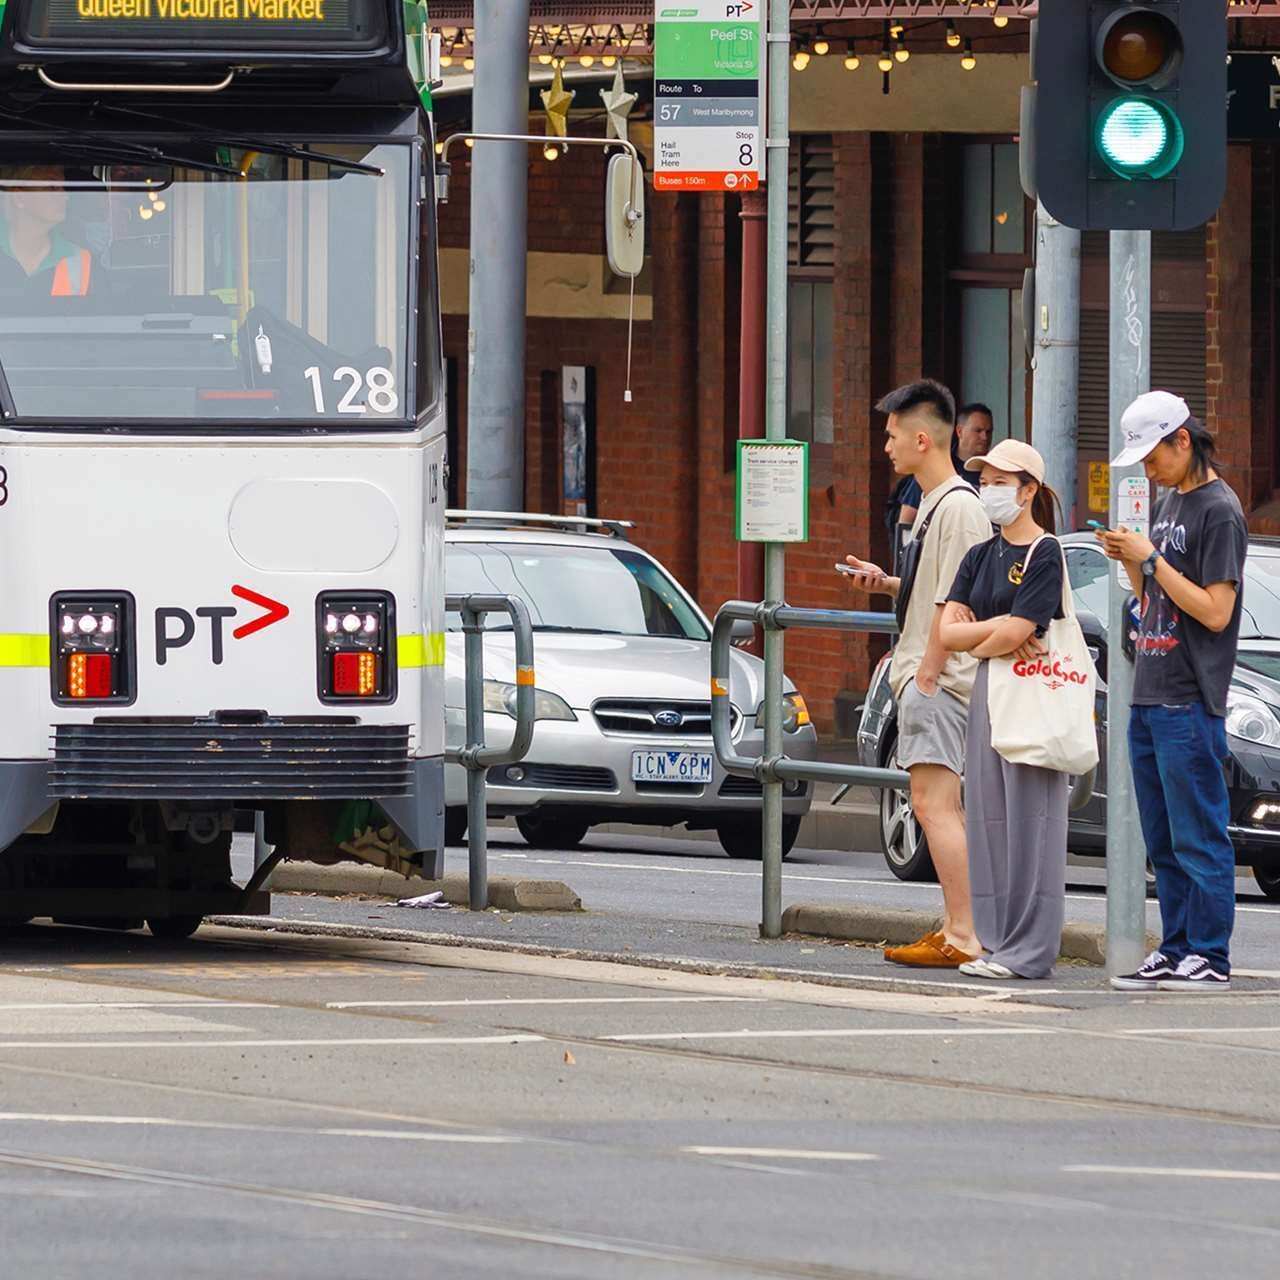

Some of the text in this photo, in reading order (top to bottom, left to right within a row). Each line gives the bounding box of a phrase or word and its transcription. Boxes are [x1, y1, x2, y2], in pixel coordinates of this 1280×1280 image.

[710, 29, 753, 40] Peel St
[714, 60, 743, 69] Victoria
[659, 84, 702, 93] Route To
[660, 104, 681, 121] 57
[692, 109, 710, 117] West
[735, 131, 754, 140] Stop
[661, 150, 681, 158] Tram
[739, 143, 753, 166] 8
[660, 159, 680, 167] Here
[659, 176, 706, 185] Buses 150m
[304, 367, 399, 414] 128
[637, 755, 710, 776] 1CN 6PM
